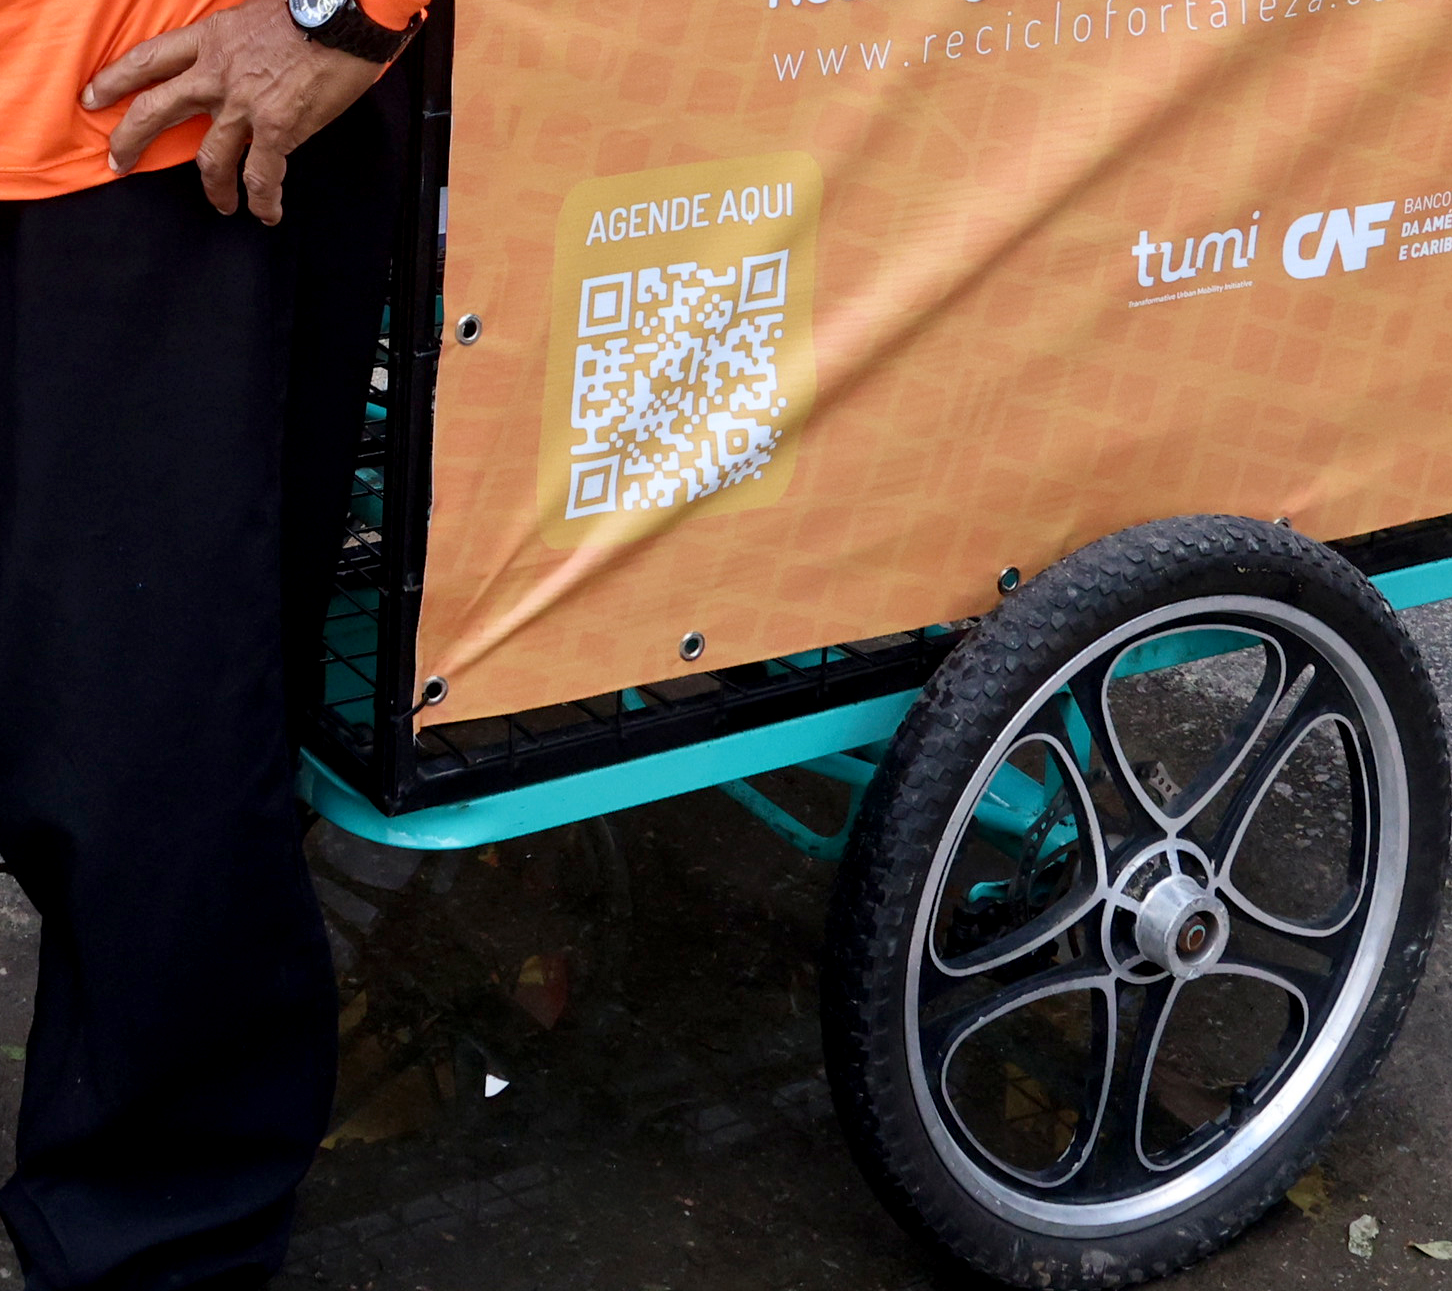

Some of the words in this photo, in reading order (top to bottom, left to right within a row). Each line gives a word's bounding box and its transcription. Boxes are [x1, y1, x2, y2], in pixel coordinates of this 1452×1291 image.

[585, 192, 712, 246] AGENDE
[716, 182, 793, 225] AQUI
[1404, 191, 1452, 215] BANCO
[1282, 200, 1396, 279] CAF
[1400, 220, 1420, 237] DA
[1131, 210, 1261, 287] tumi
[1398, 244, 1409, 261] E
[1127, 292, 1177, 308] Transformative
[1176, 288, 1197, 300] Urban
[1196, 284, 1224, 297] Mobility
[1223, 280, 1253, 291] Initiative
